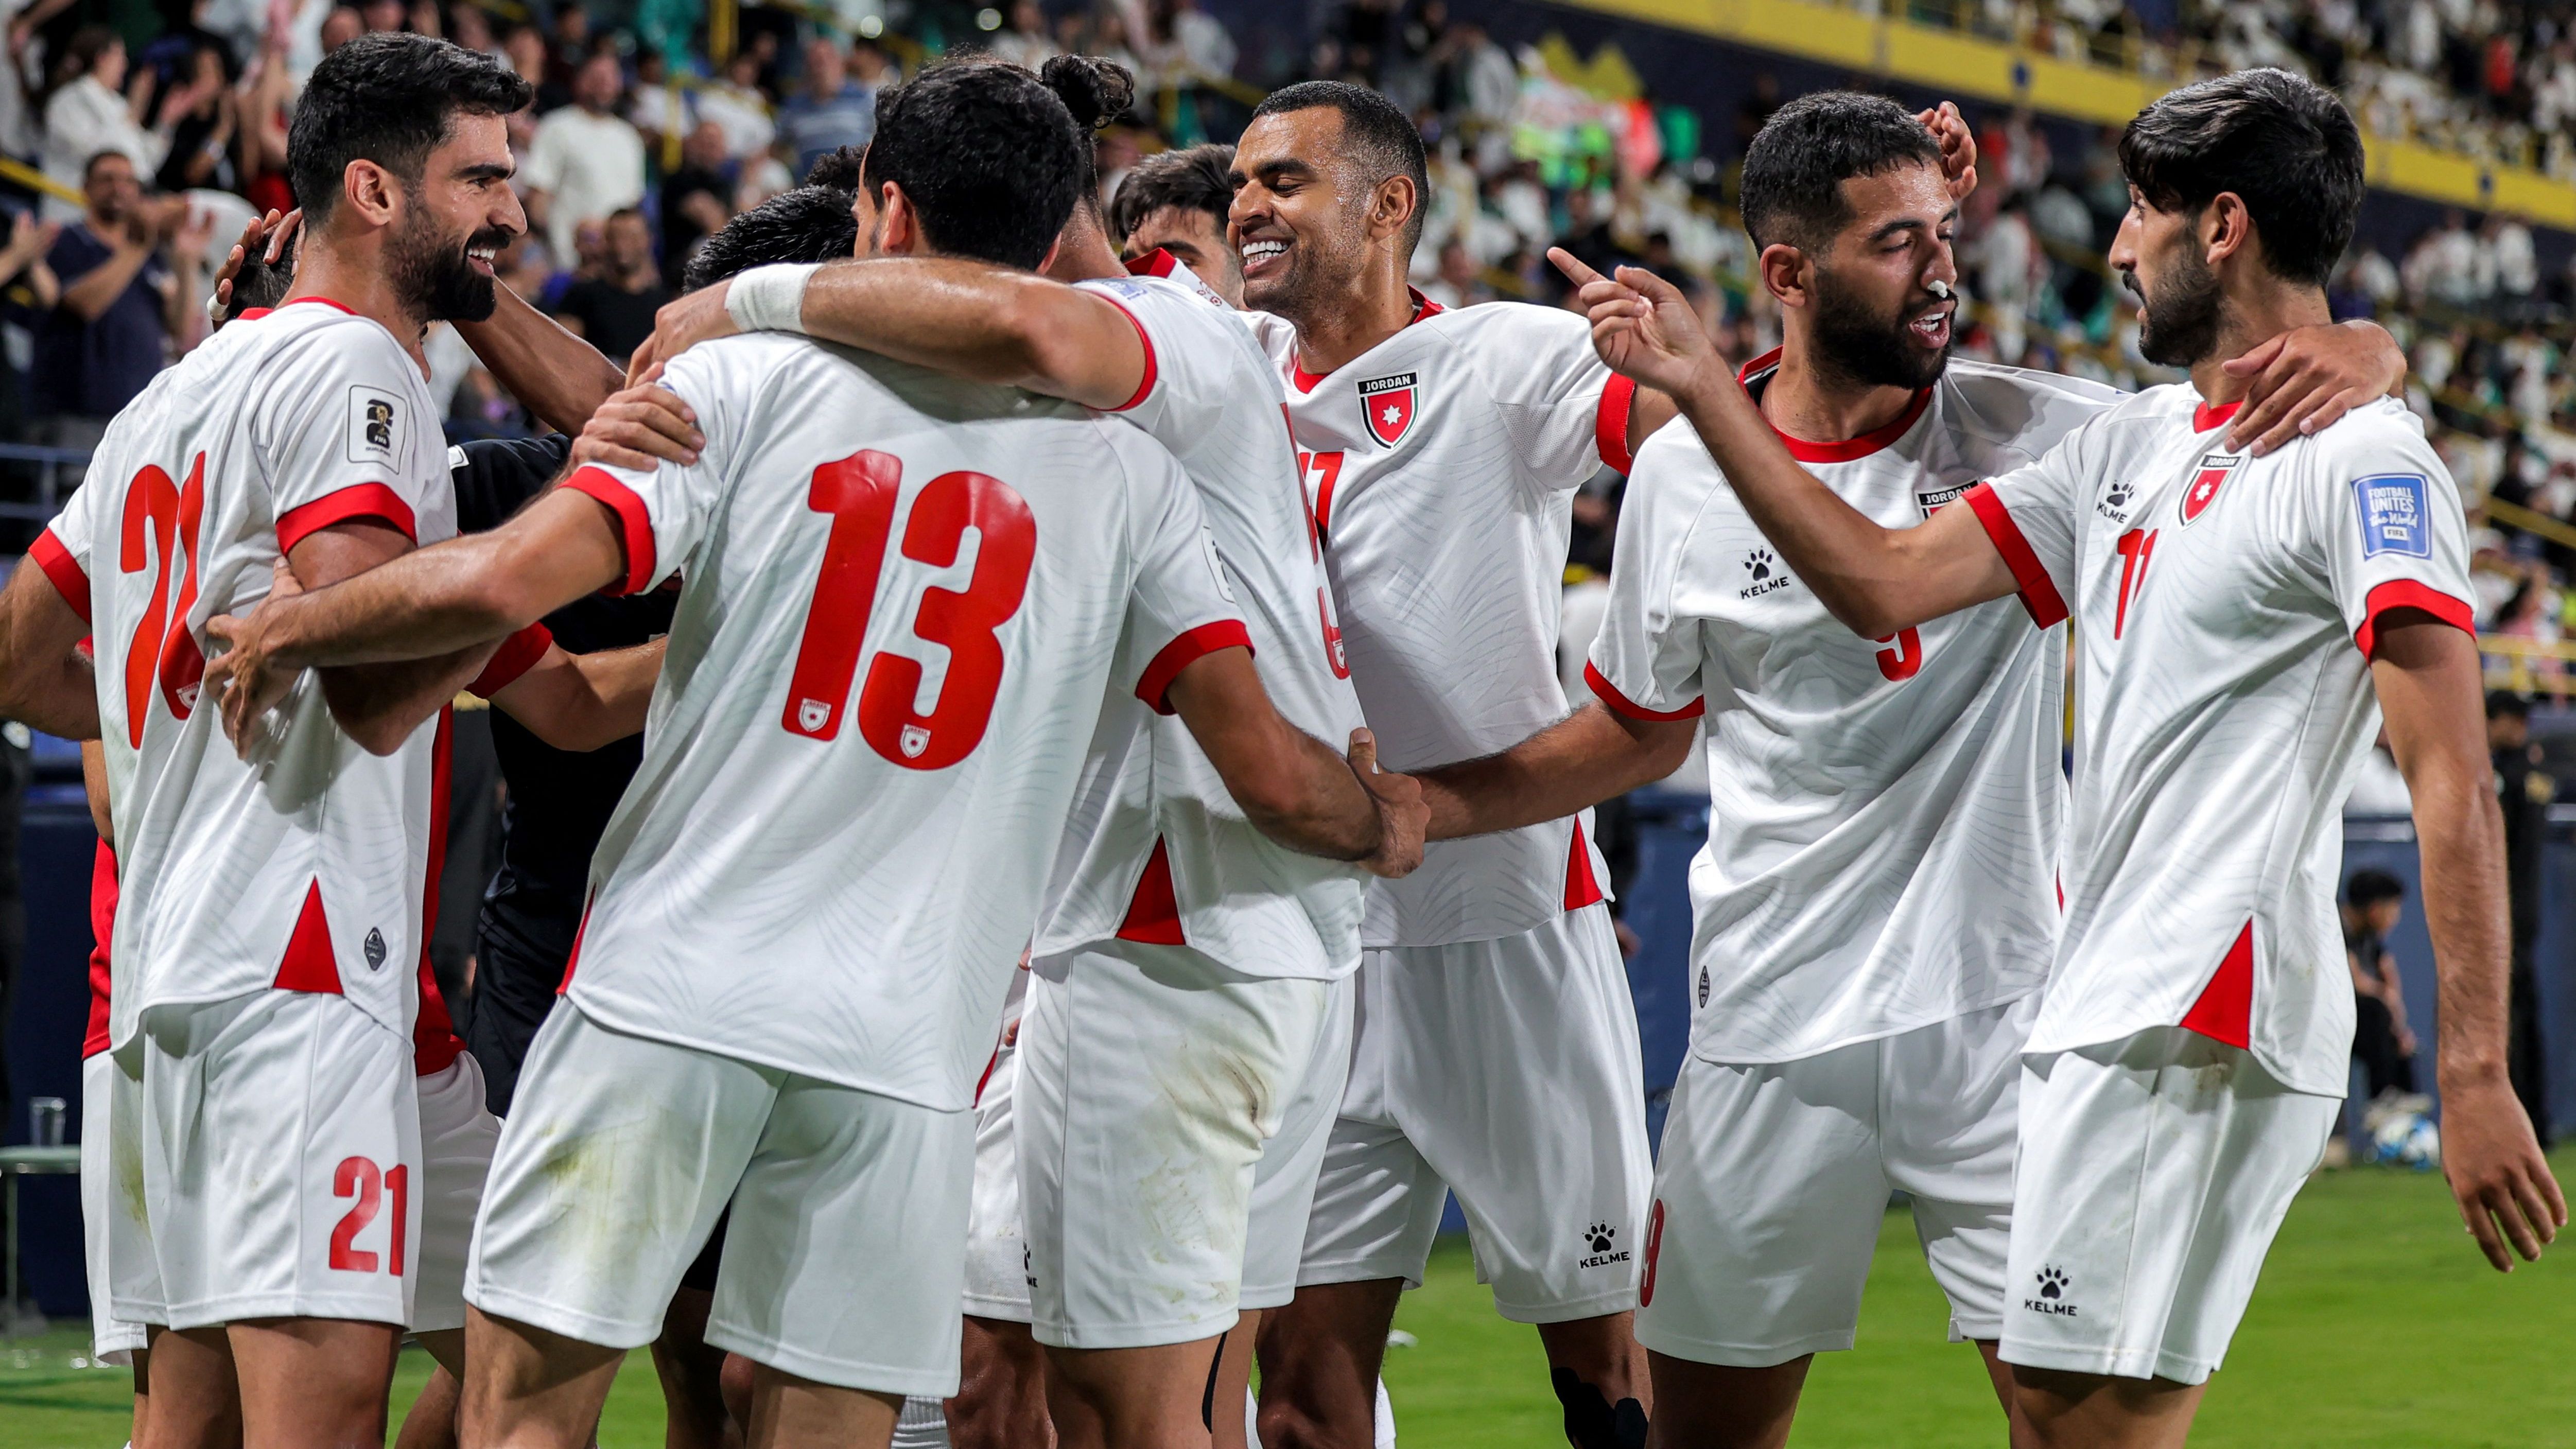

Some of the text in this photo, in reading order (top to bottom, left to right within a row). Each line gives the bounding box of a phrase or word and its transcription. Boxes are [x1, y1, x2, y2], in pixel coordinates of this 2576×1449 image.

[1366, 375, 1411, 392] JORDAN
[2368, 486, 2414, 500] FOOTBALL
[2370, 497, 2415, 513] UNITES
[1740, 576, 1789, 600] KELME
[2114, 528, 2159, 640] 11
[120, 451, 206, 750] 21
[782, 449, 1036, 770] 13
[329, 1156, 408, 1277] 21
[1580, 1251, 1630, 1269] KELME
[1640, 1198, 1665, 1308] 9
[2025, 1299, 2078, 1317] KELME
